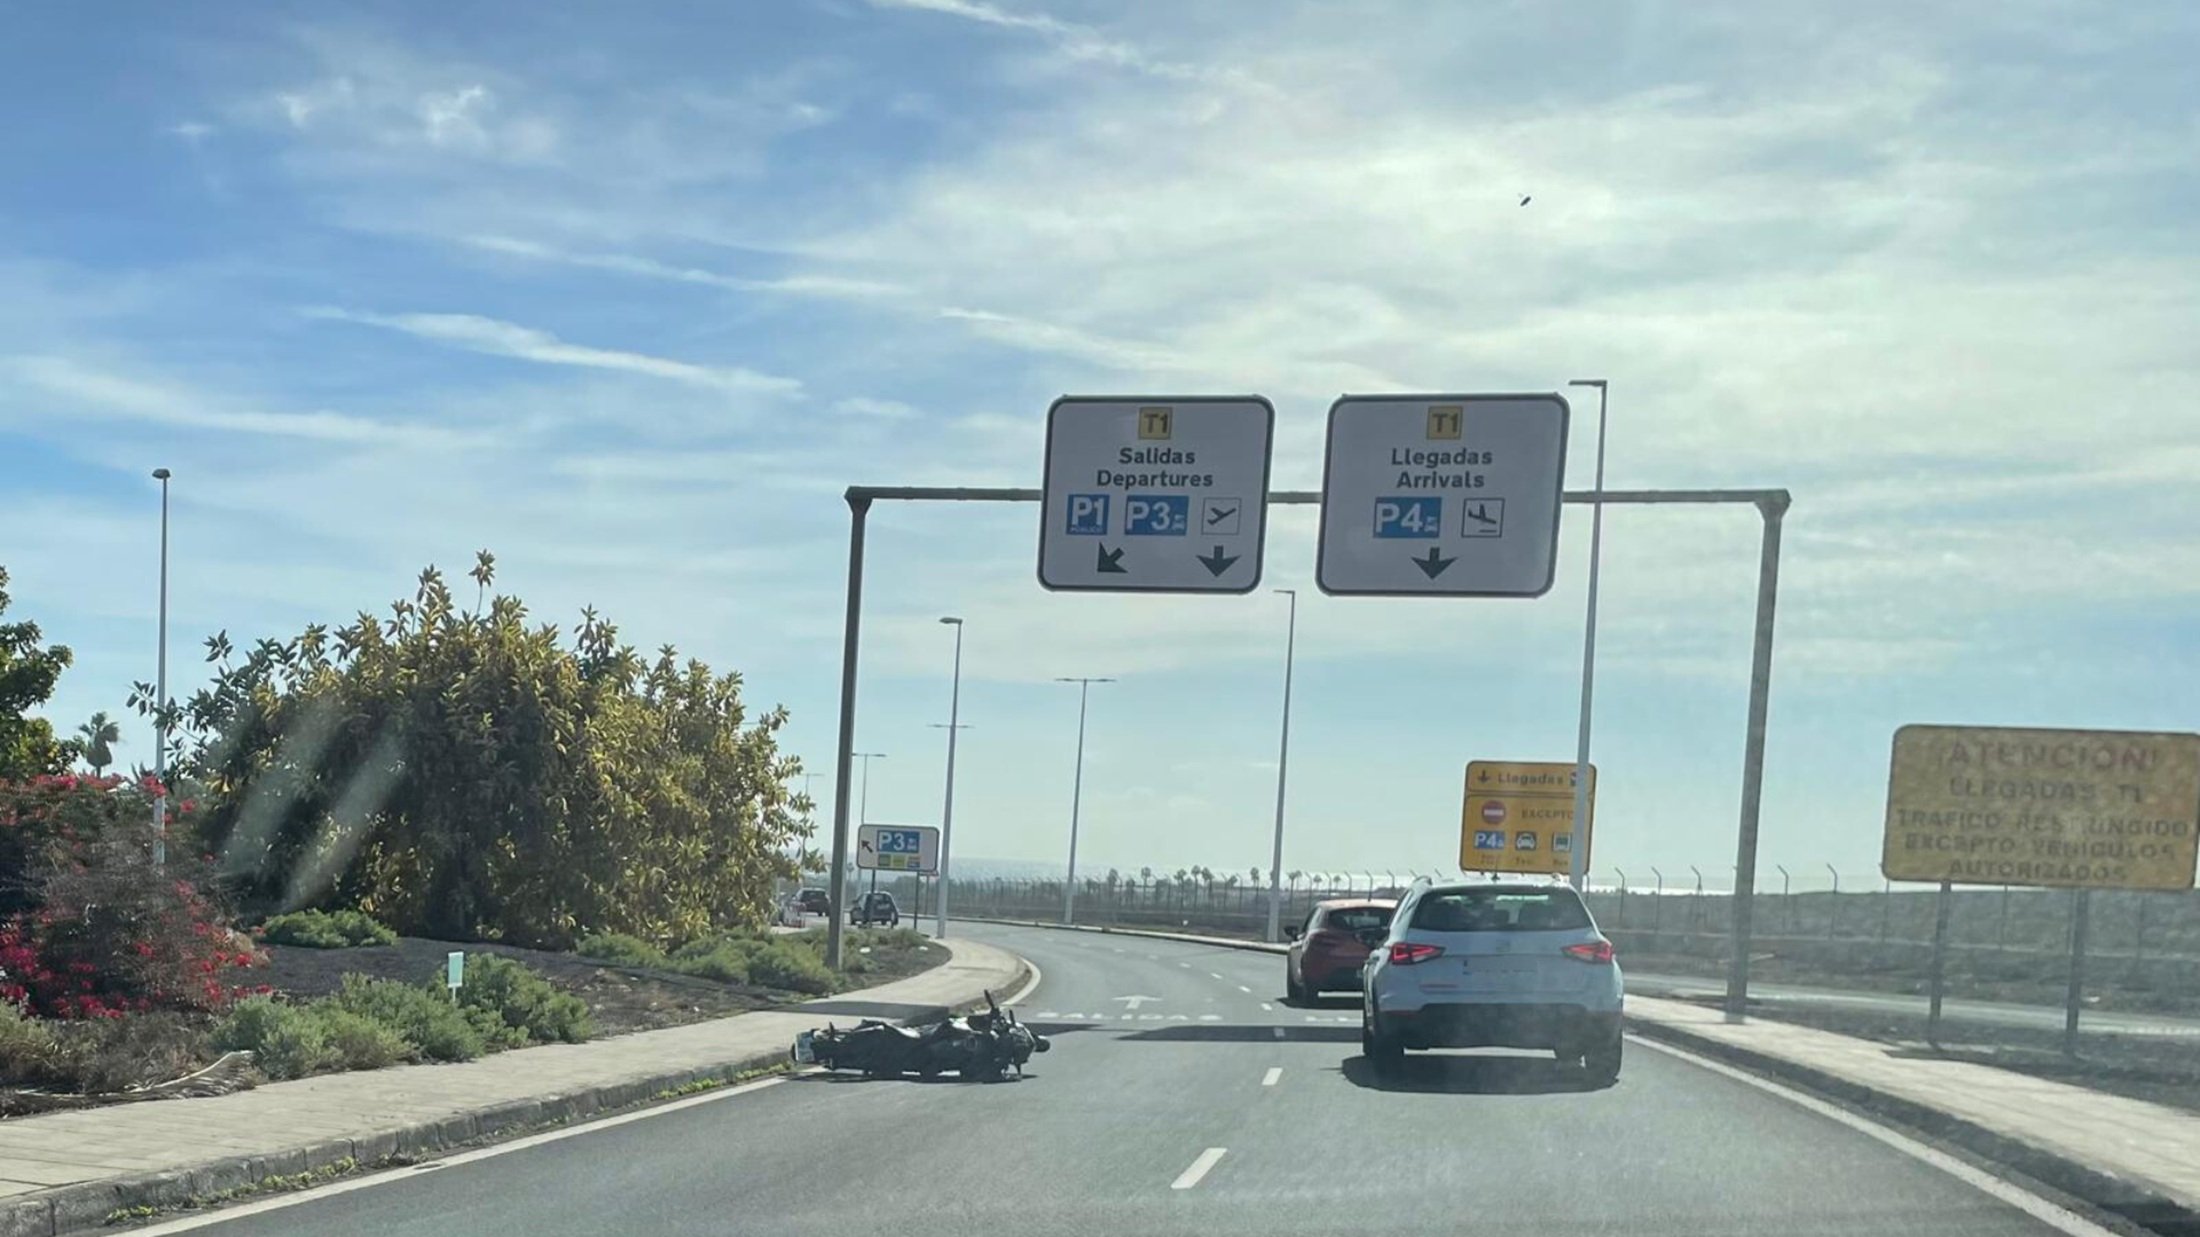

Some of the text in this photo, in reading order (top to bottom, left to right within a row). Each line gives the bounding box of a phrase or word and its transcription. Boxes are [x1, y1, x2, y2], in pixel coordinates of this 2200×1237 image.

[1144, 413, 1169, 433] T1
[1432, 413, 1458, 432] T1
[1119, 447, 1195, 464] Salidas
[1391, 447, 1492, 467] Llegadas
[1096, 470, 1213, 490] Departures
[1396, 470, 1485, 489] Arrivals
[1071, 497, 1105, 526] P1
[1126, 501, 1171, 531] P3
[1375, 503, 1423, 533] P4
[1498, 773, 1564, 785] Llegadas
[1949, 776, 2097, 801] LLEGADAS
[879, 831, 905, 851] P3
[1475, 832, 1497, 849] P4
[1905, 833, 2016, 853] EXCEPTO
[1949, 859, 2128, 882] AUTORIZADOS
